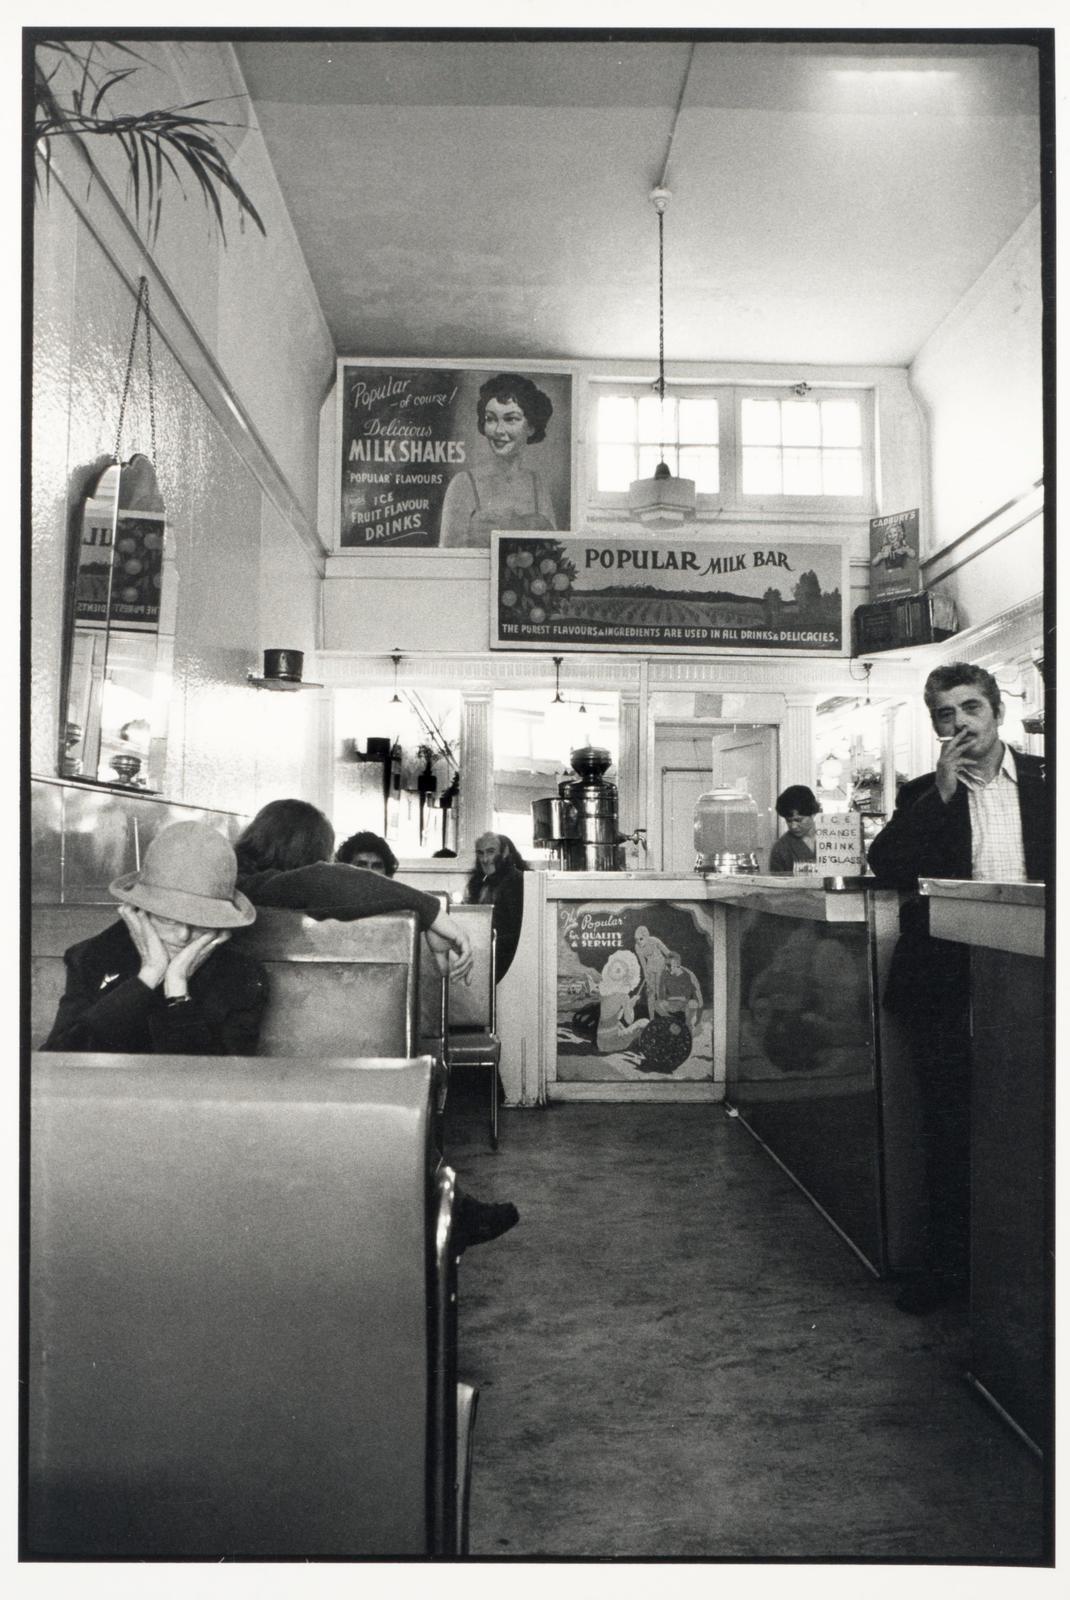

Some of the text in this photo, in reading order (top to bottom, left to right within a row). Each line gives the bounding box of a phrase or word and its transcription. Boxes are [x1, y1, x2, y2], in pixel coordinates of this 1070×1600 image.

[351, 375, 411, 411] Popular
[363, 418, 433, 437] Delicious
[395, 473, 444, 484] FLAVOURS
[374, 492, 394, 506] ICE
[351, 499, 430, 524] FRUIT FLAVOUR
[365, 513, 421, 541] DRINKS
[585, 548, 796, 576] POPULAR MILK BAR
[502, 623, 519, 634] THE
[521, 624, 550, 635] PUREST
[552, 625, 597, 636] FLAVOURS
[604, 627, 660, 638] INGREDIENTS
[663, 628, 682, 638] ARE
[684, 628, 708, 639] USED
[710, 629, 721, 639] IN
[722, 629, 739, 640] ALL
[740, 630, 773, 640] DRINKS
[820, 815, 851, 824] ICE
[816, 828, 857, 837] ORANGE
[819, 841, 855, 851] DRINK
[582, 931, 623, 940] QUALITY
[582, 939, 625, 948] SERVICE
